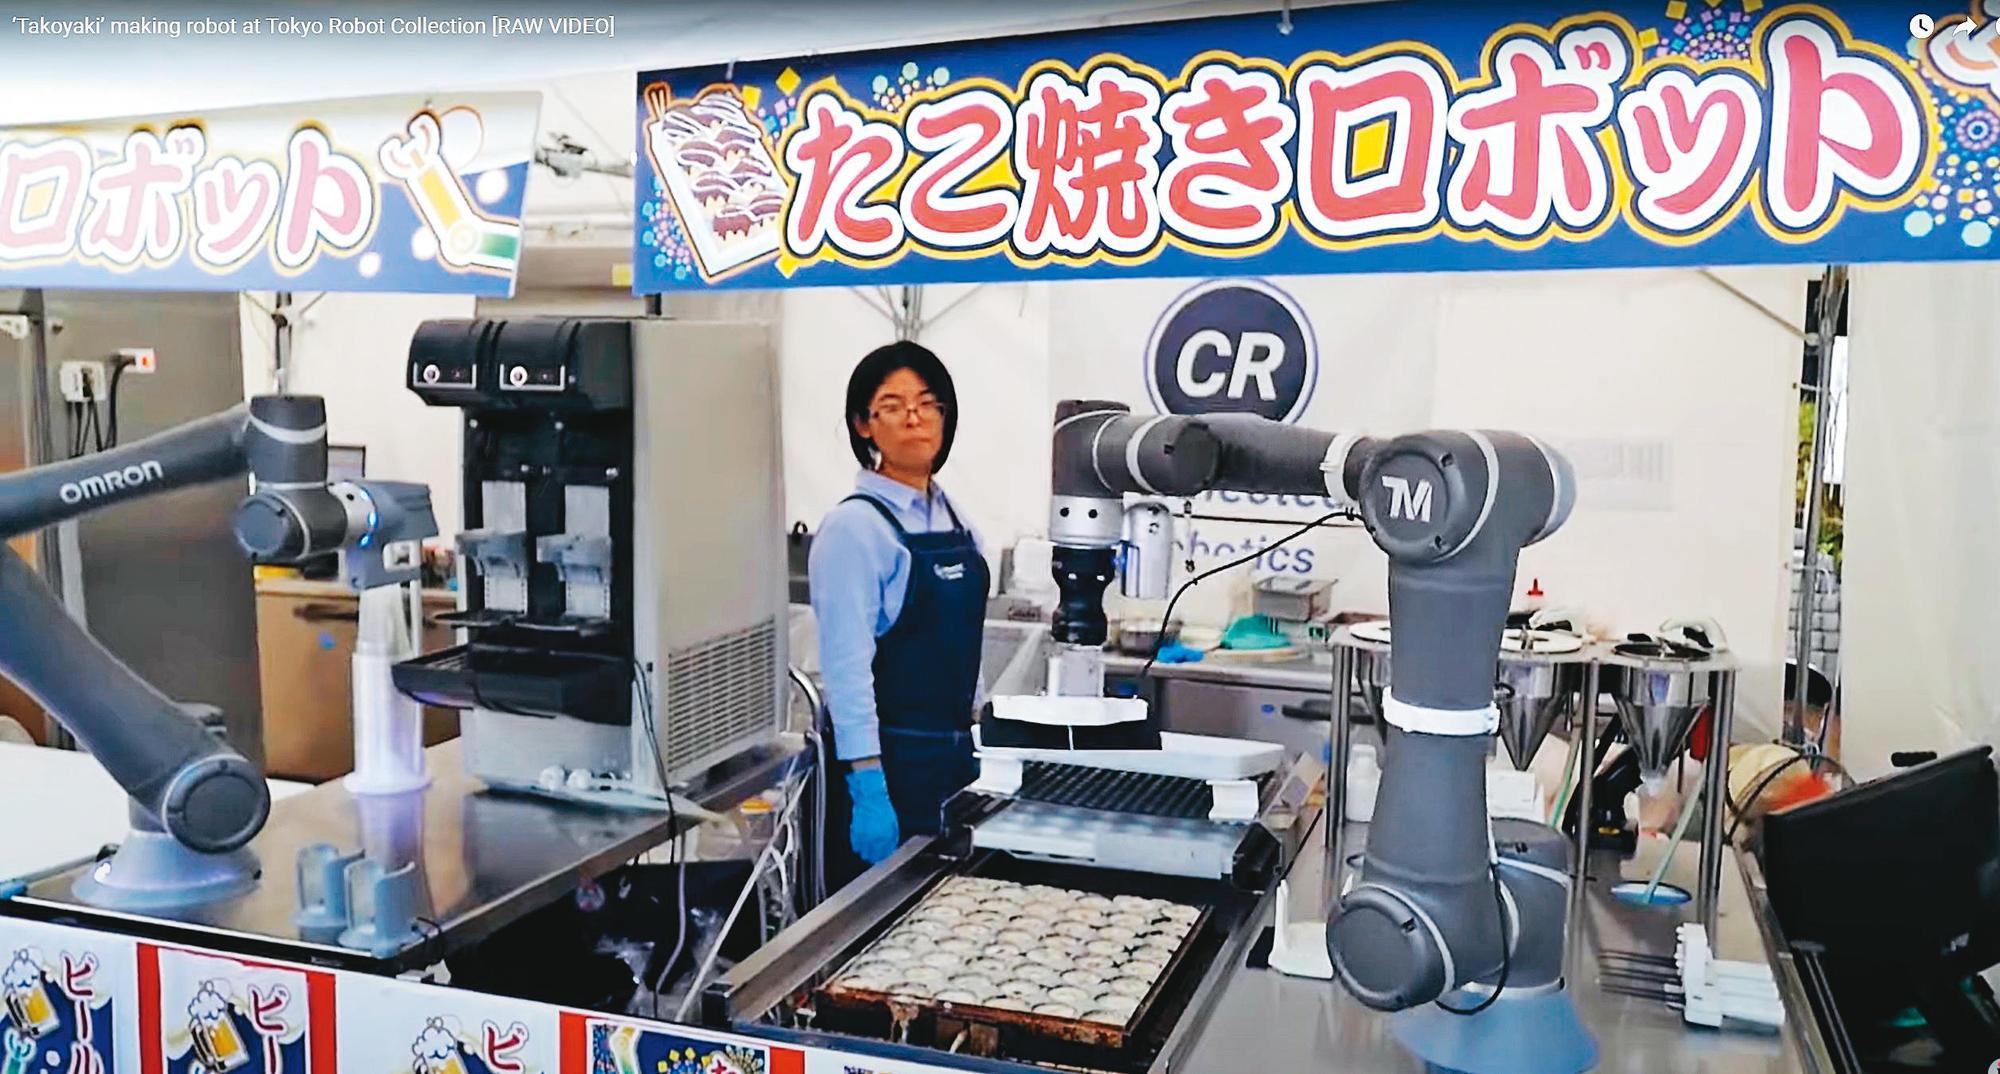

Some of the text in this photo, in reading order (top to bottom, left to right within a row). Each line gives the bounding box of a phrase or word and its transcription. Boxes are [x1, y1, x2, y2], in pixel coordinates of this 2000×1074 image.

[792, 30, 1910, 248] たこ焼きロボット
[0, 136, 366, 258] ロボット
[1176, 329, 1286, 401] CR
[60, 460, 163, 504] OMRON
[1381, 475, 1433, 523] TM
